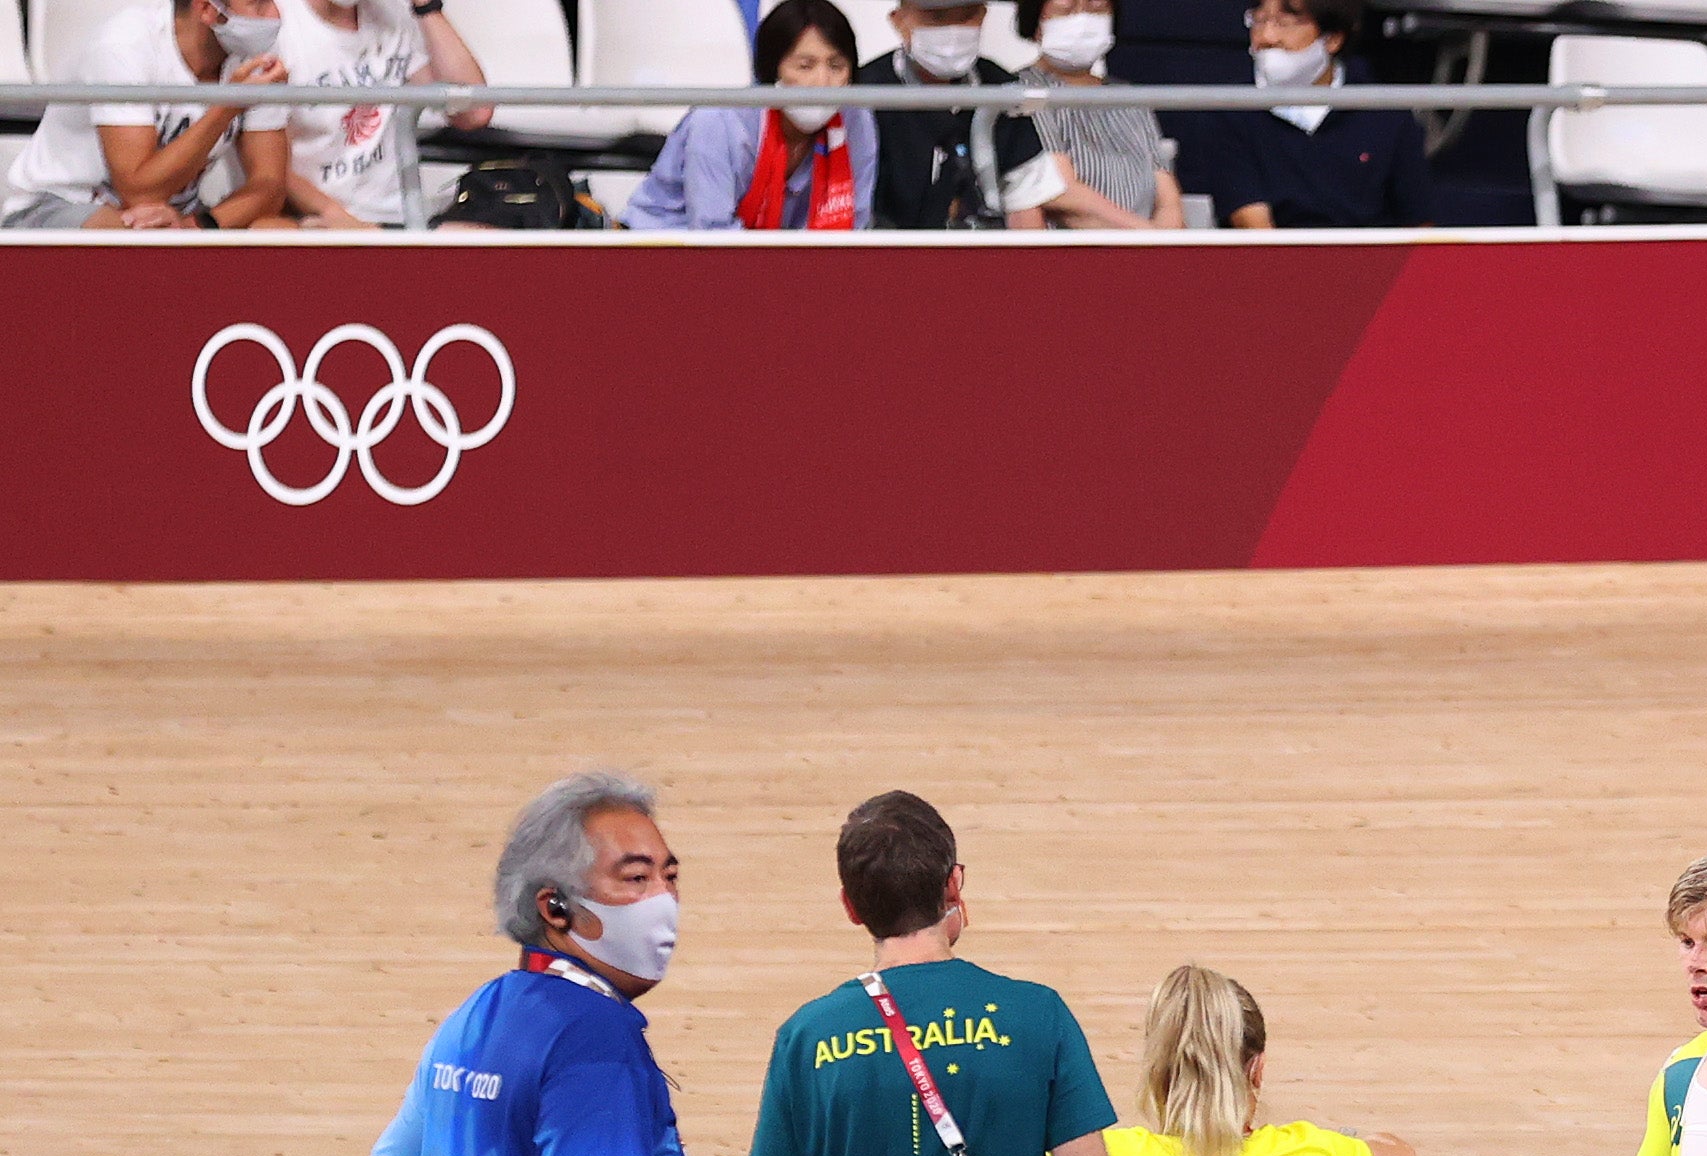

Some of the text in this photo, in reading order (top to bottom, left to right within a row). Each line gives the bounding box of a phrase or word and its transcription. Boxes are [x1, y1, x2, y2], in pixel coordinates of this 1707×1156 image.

[814, 1017, 1001, 1070] AUSTRALIA
[909, 1058, 943, 1115] TOKYO 2020
